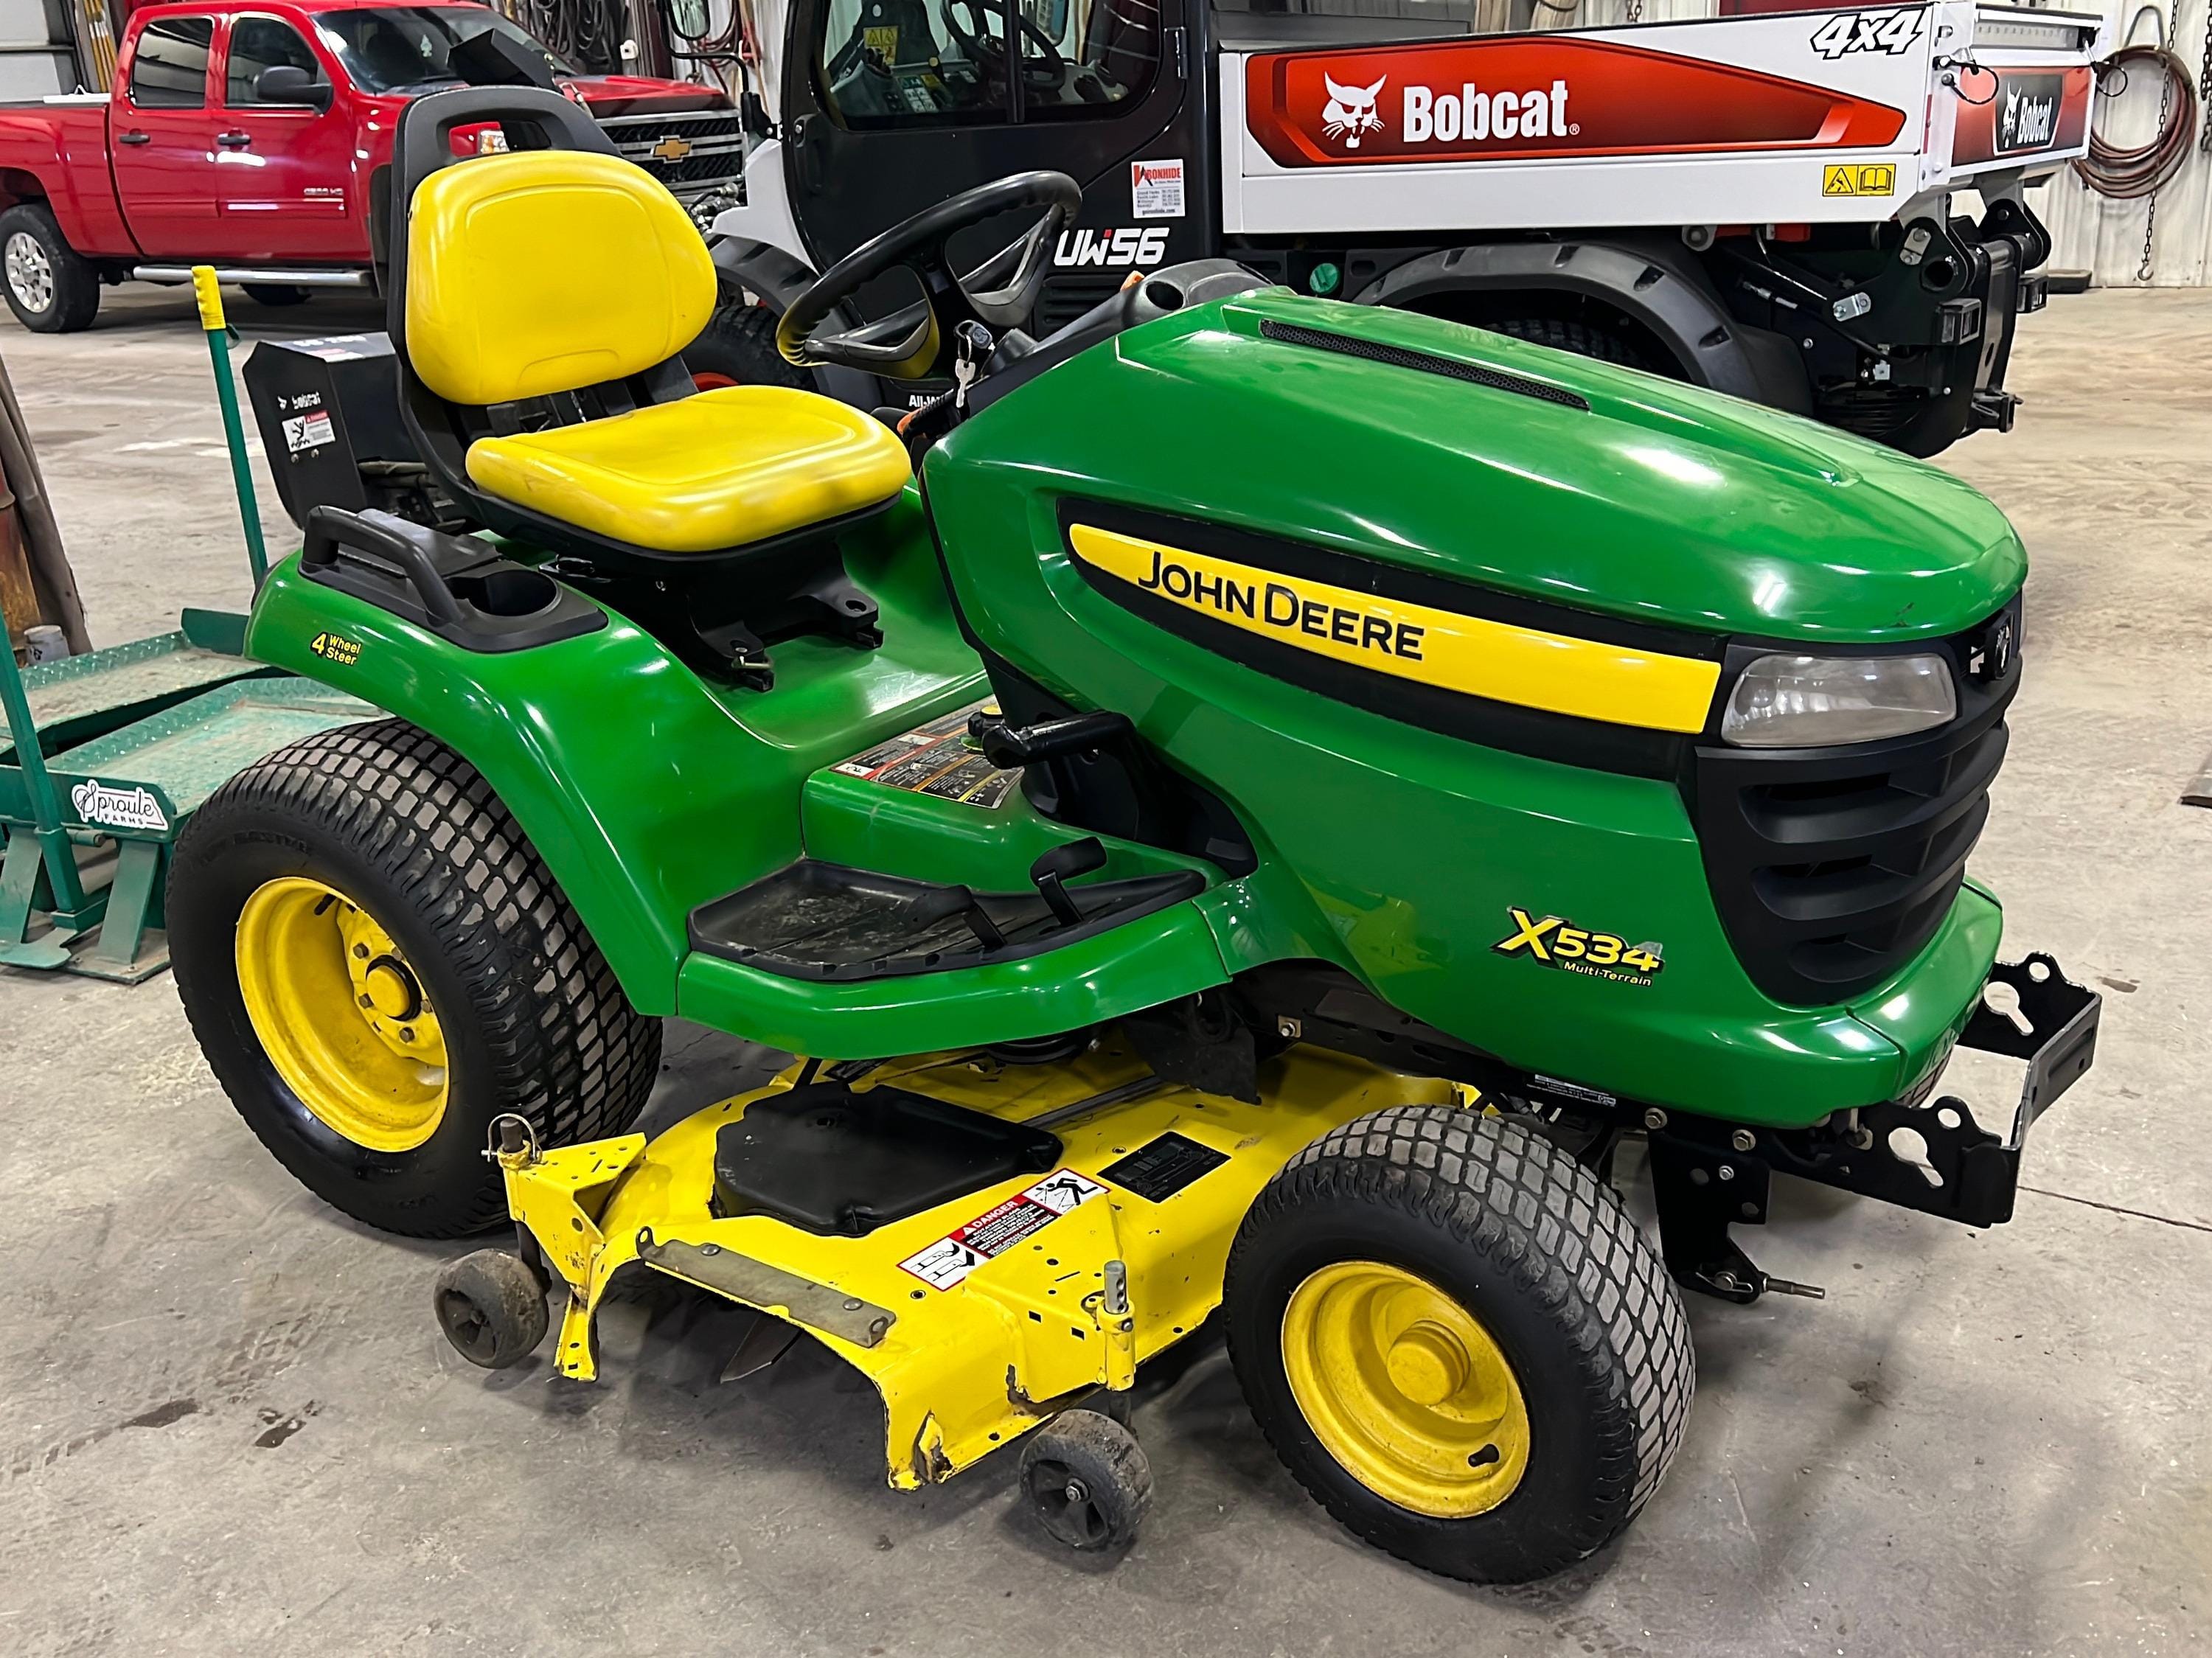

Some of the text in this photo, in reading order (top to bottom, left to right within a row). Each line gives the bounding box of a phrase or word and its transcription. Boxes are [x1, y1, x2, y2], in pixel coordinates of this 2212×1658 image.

[1810, 8, 1924, 60] 4x4
[1403, 80, 1568, 142] Bobcat
[2017, 96, 2053, 144] Bobcat
[1054, 227, 1169, 266] UW56
[1138, 551, 1425, 661] JOHN DEERE
[311, 633, 361, 655] 4 Wheel
[326, 646, 357, 666] Steer
[74, 783, 154, 818] Sproule
[104, 813, 143, 825] FARMS
[1494, 908, 1662, 973] X534
[1563, 961, 1652, 987] Multi-Terrain
[972, 1200, 1019, 1228] DANGER
